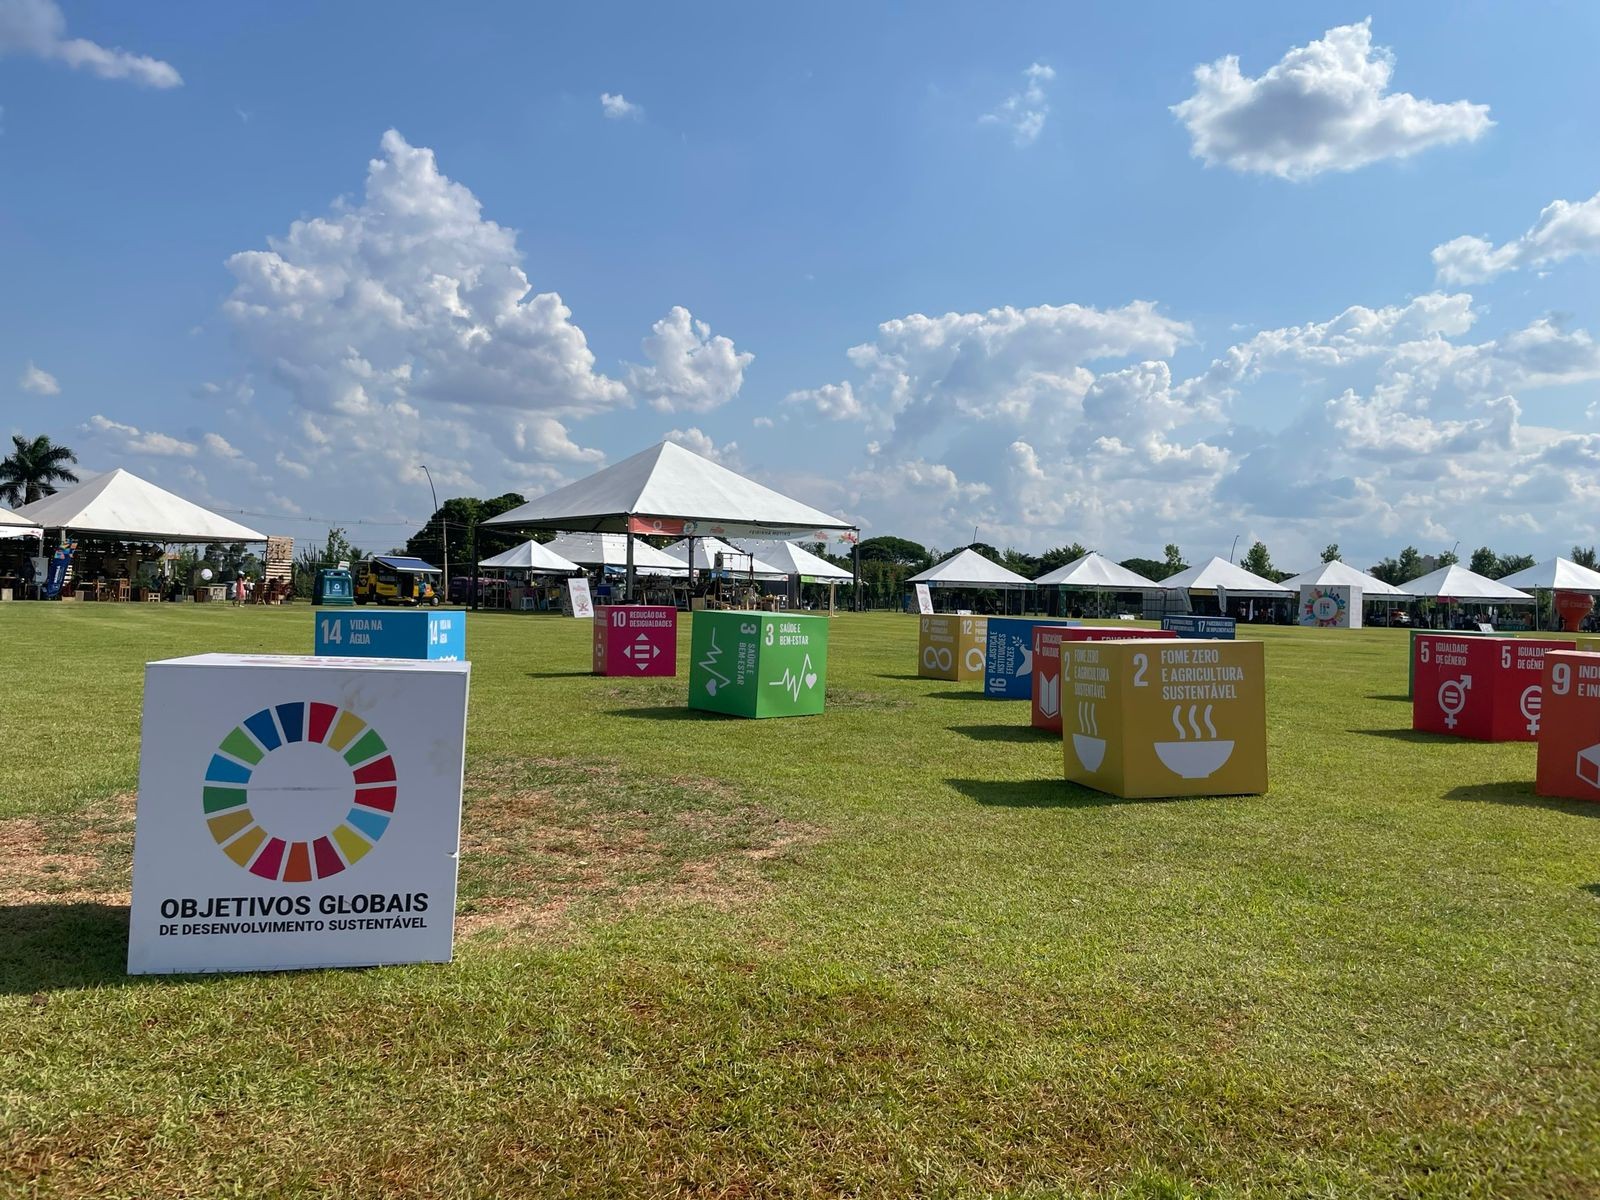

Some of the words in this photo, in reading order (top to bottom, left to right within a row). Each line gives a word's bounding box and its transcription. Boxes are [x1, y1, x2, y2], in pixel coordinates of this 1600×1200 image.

[612, 611, 626, 627] 10
[630, 611, 655, 619] REDUÇÃO
[321, 619, 342, 644] 14
[350, 620, 369, 630] VIDA
[371, 620, 382, 630] NA
[630, 620, 672, 628] DESIGUALDADES
[741, 623, 756, 634] 3
[780, 622, 797, 633] SAÚDE
[798, 624, 801, 632] E
[922, 618, 929, 632] 12
[963, 620, 973, 634] 12
[1198, 621, 1205, 632] 17
[349, 633, 370, 644] ÁGUA
[430, 620, 438, 644] 14
[766, 623, 774, 646] 3
[780, 636, 809, 646] BEM-ESTAR
[1035, 633, 1040, 655] 4
[1436, 642, 1469, 654] IGUALDADE
[1161, 650, 1189, 664] FOME
[1192, 649, 1219, 664] ZERO
[1421, 641, 1430, 663] 5
[1502, 646, 1511, 668] 5
[737, 643, 746, 685] BEM-ESTAR
[1006, 647, 1014, 675] EFICAZES
[1065, 651, 1070, 682] 2
[1436, 655, 1443, 664] DE
[1444, 654, 1467, 666] GÊNERO
[1518, 659, 1525, 669] DE
[1526, 658, 1544, 669] GÊNE
[1133, 653, 1148, 687] 2
[1162, 668, 1168, 682] E
[1171, 667, 1244, 682] AGRICULTURA
[1579, 665, 1600, 679] IND
[990, 678, 1007, 693] 16
[1552, 663, 1571, 695] 9
[1162, 683, 1237, 700] SUSTENTÁVEL
[1577, 683, 1584, 696] E
[1587, 684, 1600, 697] IN
[160, 896, 311, 919] OBJETIVOS
[319, 892, 429, 915] GLOBAIS
[159, 924, 178, 936] DE
[182, 920, 325, 935] DESENVOLVIMENTO
[329, 915, 428, 931] SUSTENTÁVEL
